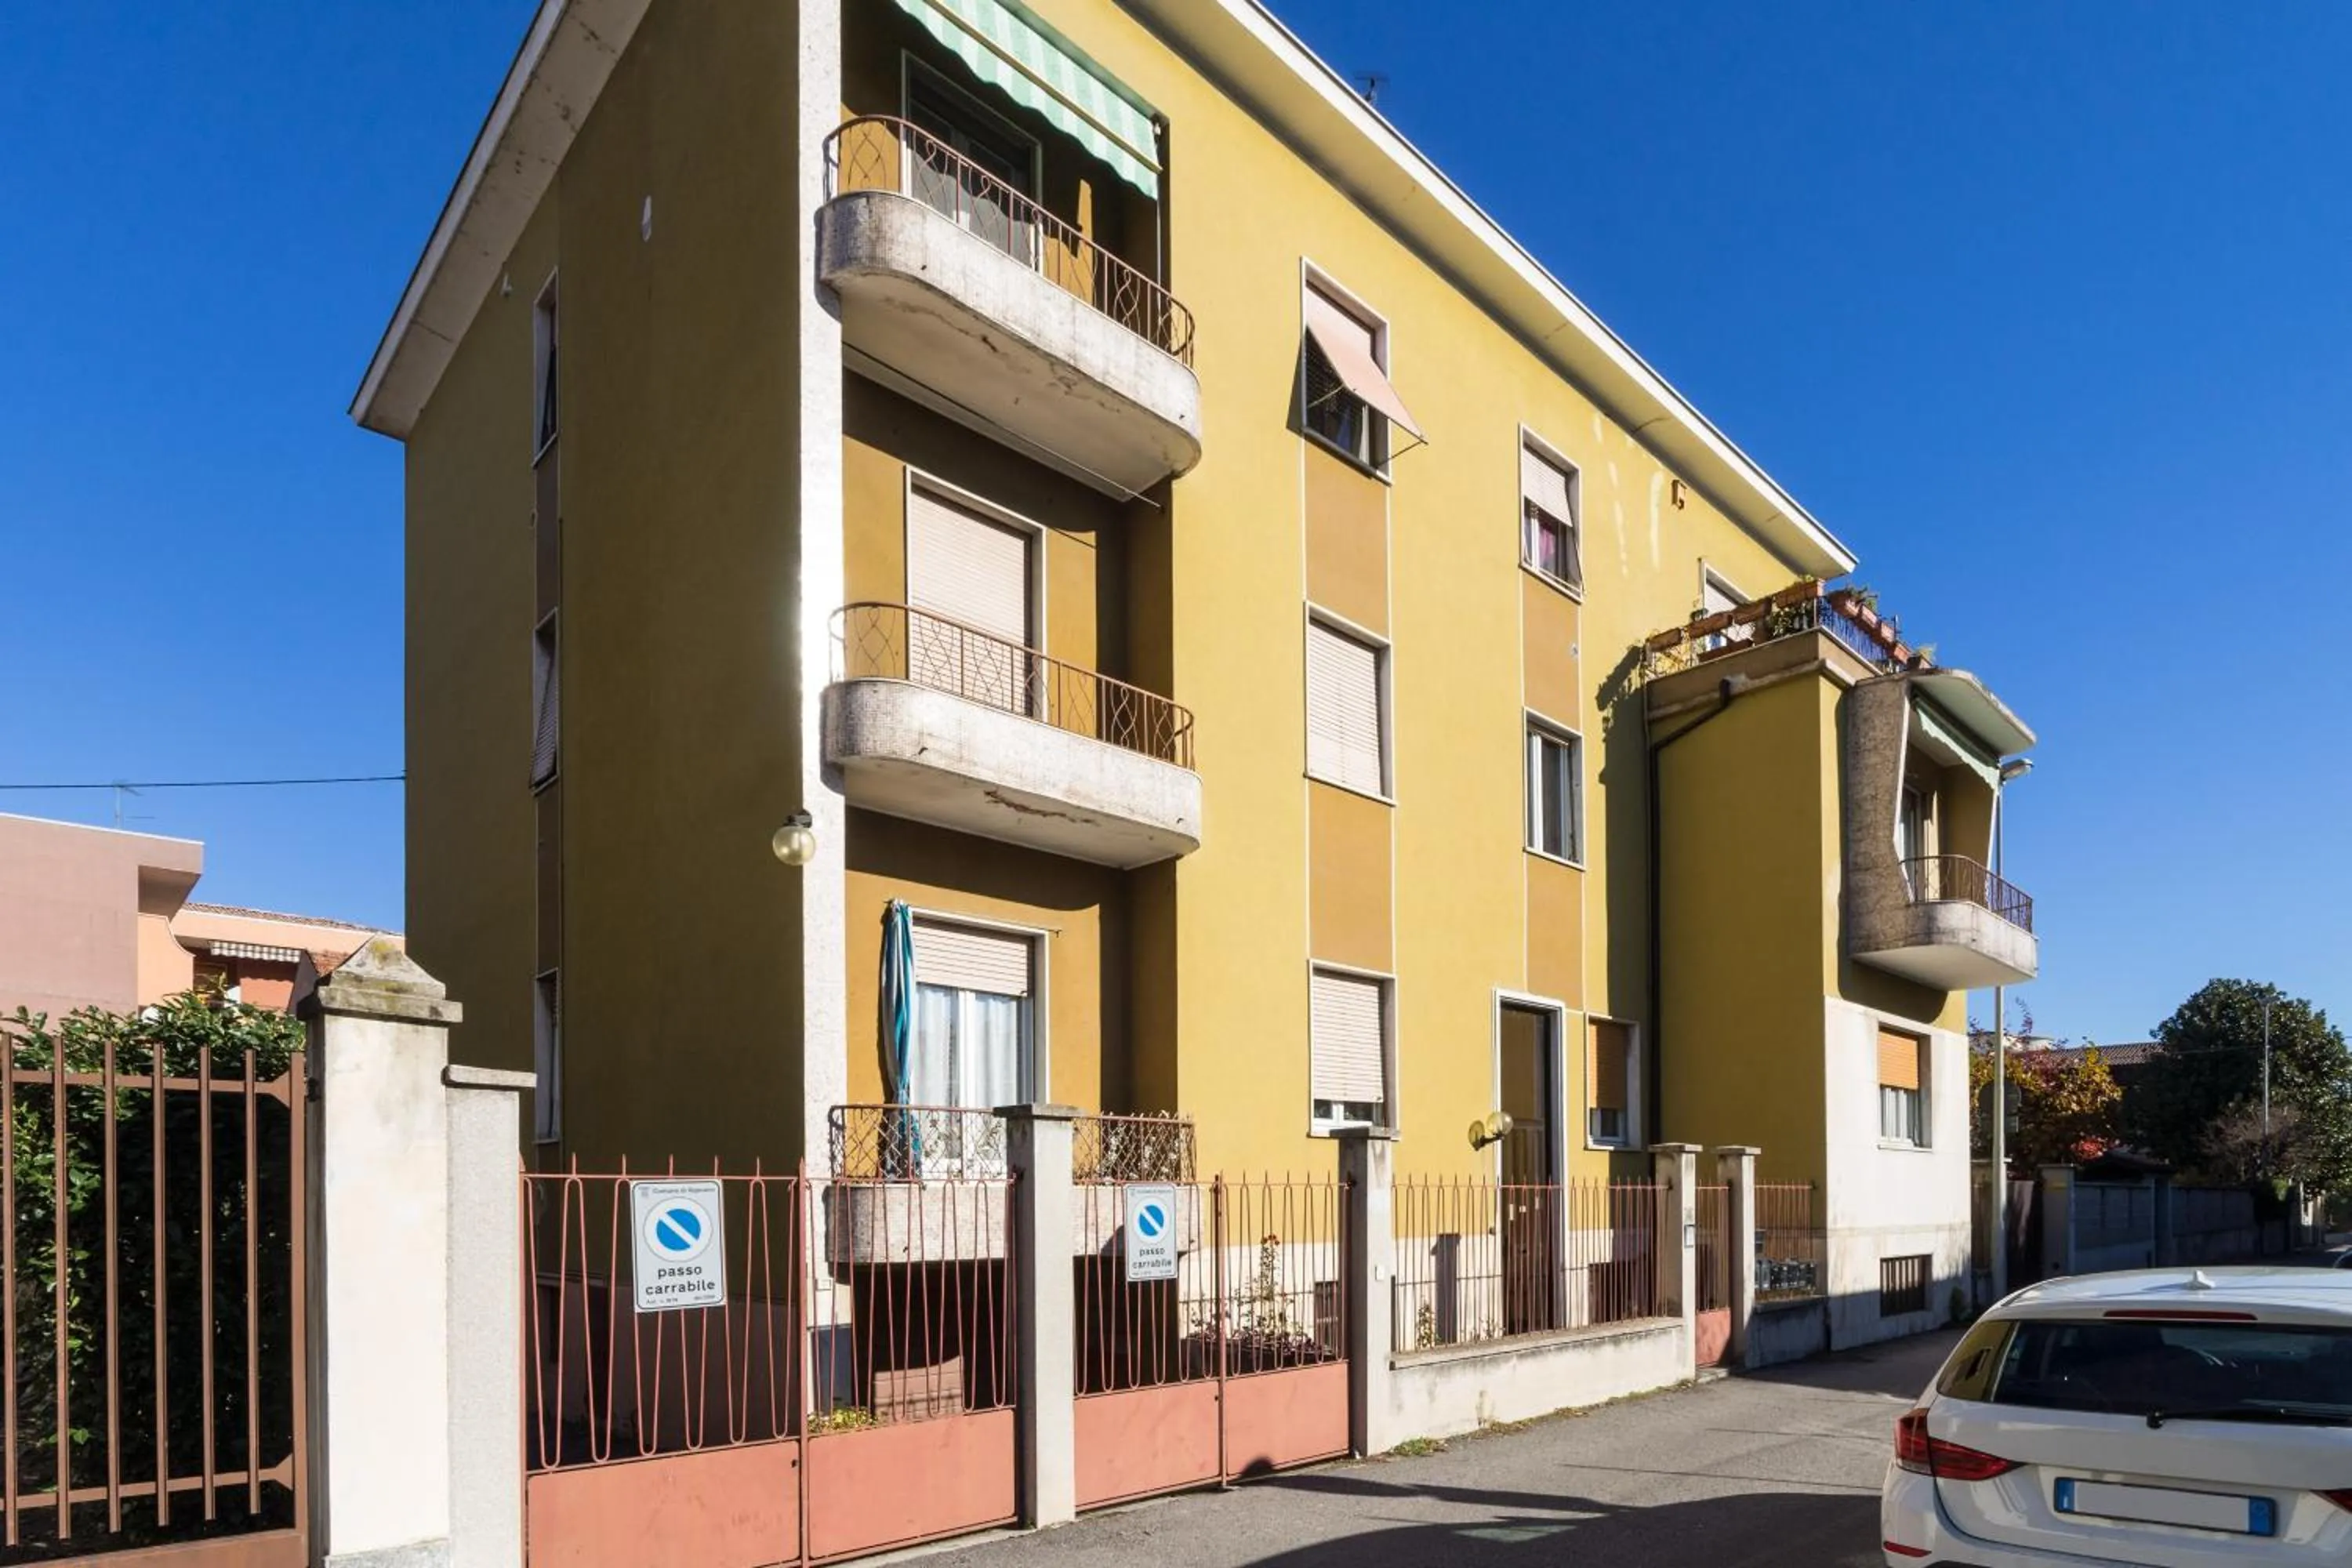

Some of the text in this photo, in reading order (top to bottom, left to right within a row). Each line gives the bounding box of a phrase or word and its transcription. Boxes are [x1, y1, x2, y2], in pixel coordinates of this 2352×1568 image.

[1139, 1248, 1165, 1258] passo
[1132, 1258, 1172, 1269] carrabile
[658, 1266, 702, 1279] passo
[645, 1280, 715, 1295] carrabile
